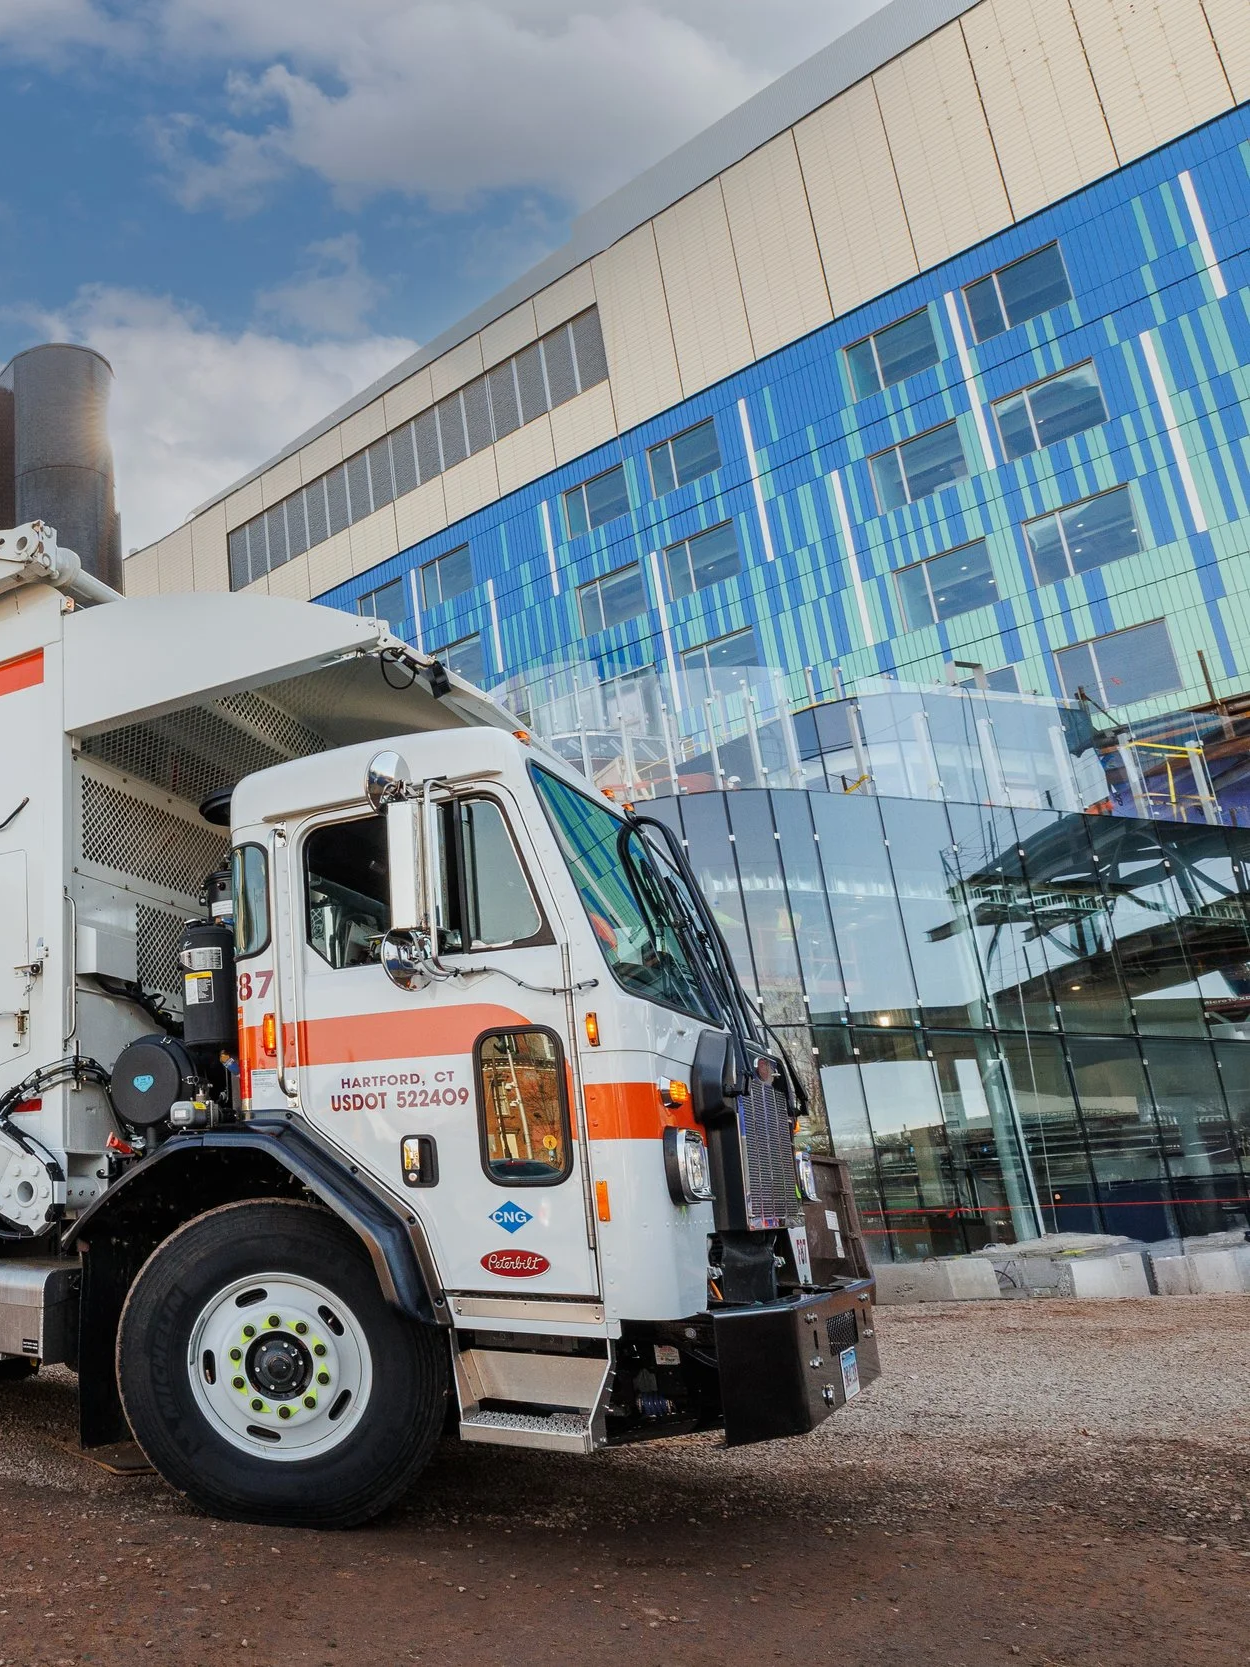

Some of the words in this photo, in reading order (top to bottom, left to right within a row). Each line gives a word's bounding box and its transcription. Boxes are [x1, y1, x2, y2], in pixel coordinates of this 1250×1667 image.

[341, 1073, 426, 1089] HARTFORD,
[434, 1071, 455, 1083] CT
[331, 1092, 387, 1112] USDOT
[396, 1087, 469, 1108] 522409
[492, 1211, 527, 1223] CNG
[488, 1254, 544, 1270] Peterbilt
